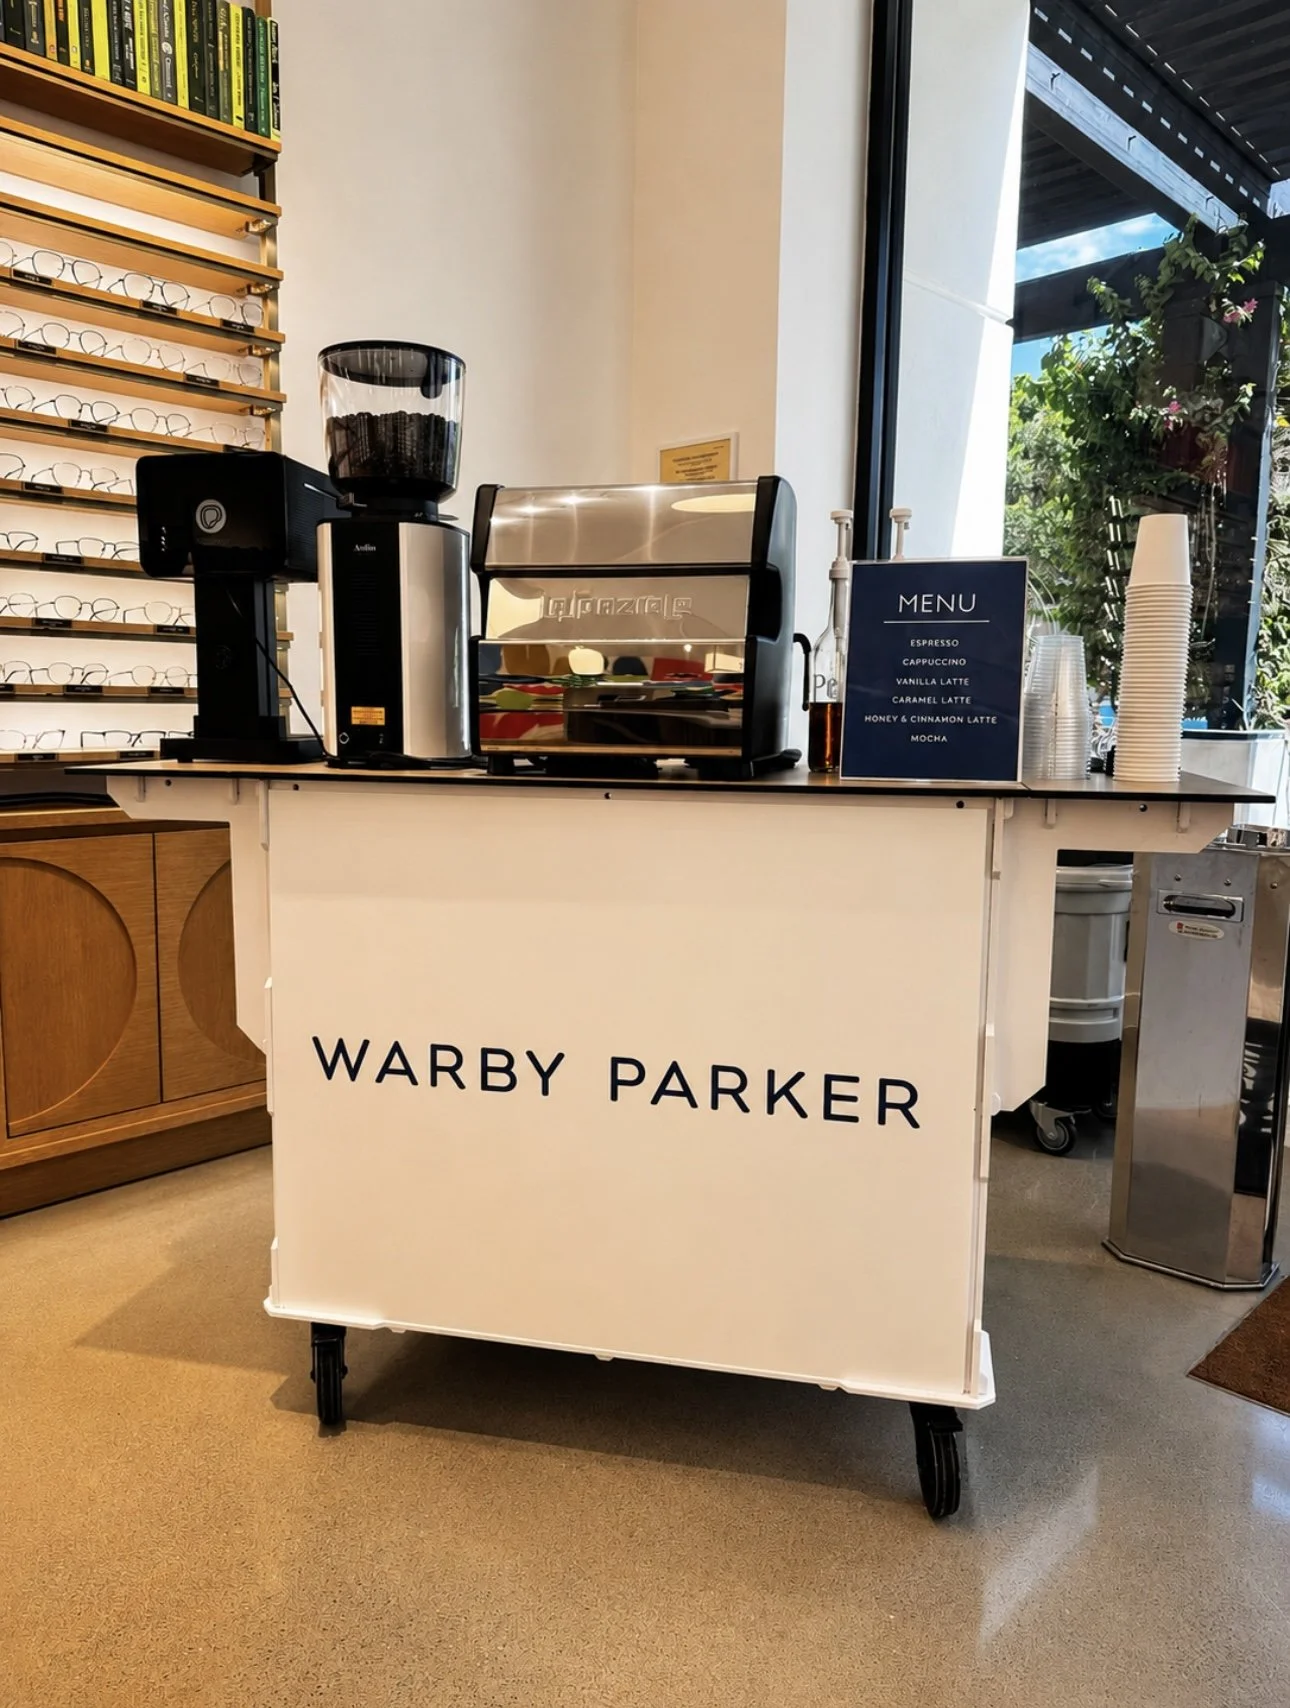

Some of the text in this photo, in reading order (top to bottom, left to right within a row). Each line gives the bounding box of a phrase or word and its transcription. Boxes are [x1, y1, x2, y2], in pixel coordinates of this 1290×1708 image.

[898, 593, 977, 613] MENU
[910, 639, 959, 647] ESPRESSO
[902, 658, 967, 666] CAPPUCCINO
[896, 677, 969, 686] VANILLA LATTE
[892, 696, 971, 705] CARAMEL LATTE
[864, 715, 997, 724] HONEY & CINNAMON LATTE
[910, 734, 948, 742] MOCHA
[312, 1036, 921, 1129] WARBY PARKER
